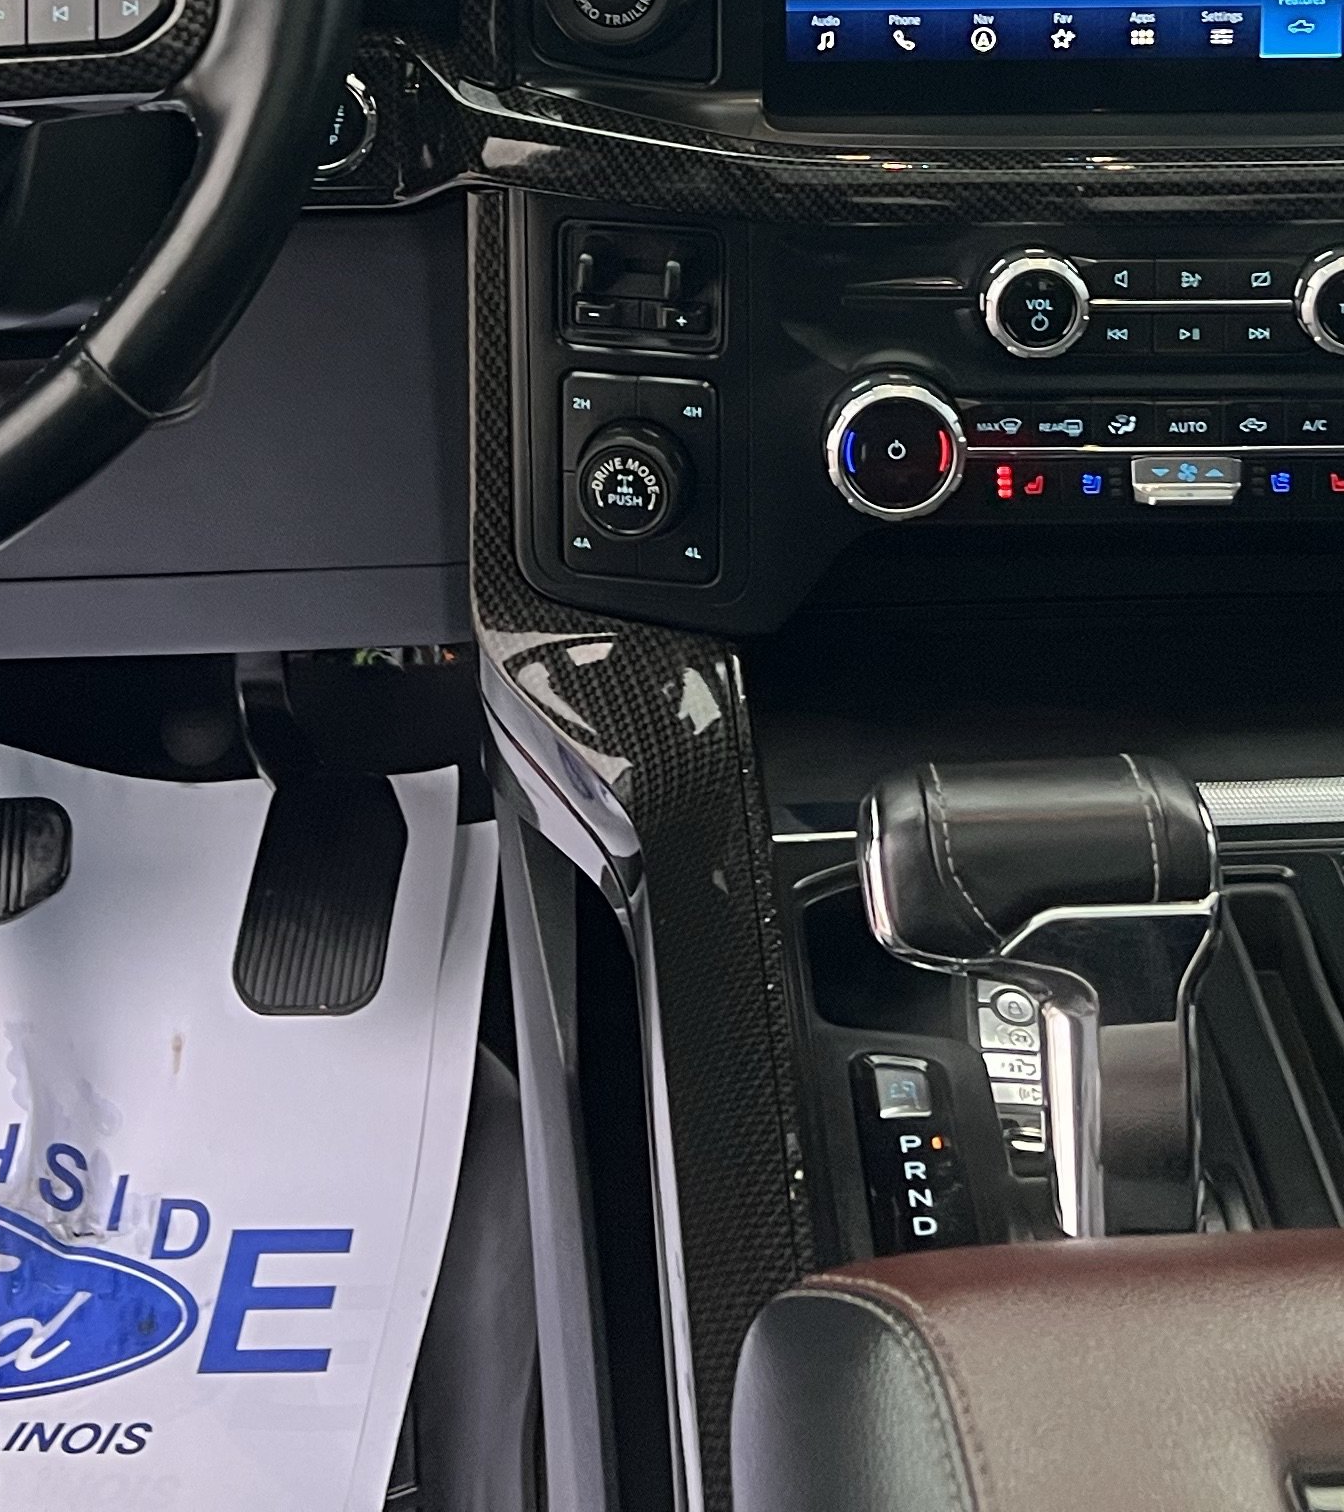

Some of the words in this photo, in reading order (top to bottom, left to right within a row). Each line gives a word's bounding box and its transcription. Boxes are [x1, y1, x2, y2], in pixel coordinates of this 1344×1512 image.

[811, 15, 841, 28] Audio
[888, 14, 921, 27] Phone
[973, 14, 995, 26] Nav
[1052, 12, 1073, 25] Fav
[1129, 11, 1156, 25] Apps
[1200, 10, 1244, 24] Settings
[1026, 299, 1054, 311] VOL
[572, 397, 592, 411] 2H
[683, 406, 703, 419] 4H
[1168, 420, 1208, 433] AUTO
[1302, 419, 1328, 432] A/C
[591, 457, 624, 491] DRIVE
[625, 458, 661, 495] MODE
[607, 493, 643, 507] PUSH
[573, 537, 592, 550] 4A
[685, 547, 702, 559] 4L
[899, 1135, 922, 1154] P
[904, 1161, 927, 1180] R
[908, 1189, 933, 1208] N
[912, 1216, 938, 1236] D
